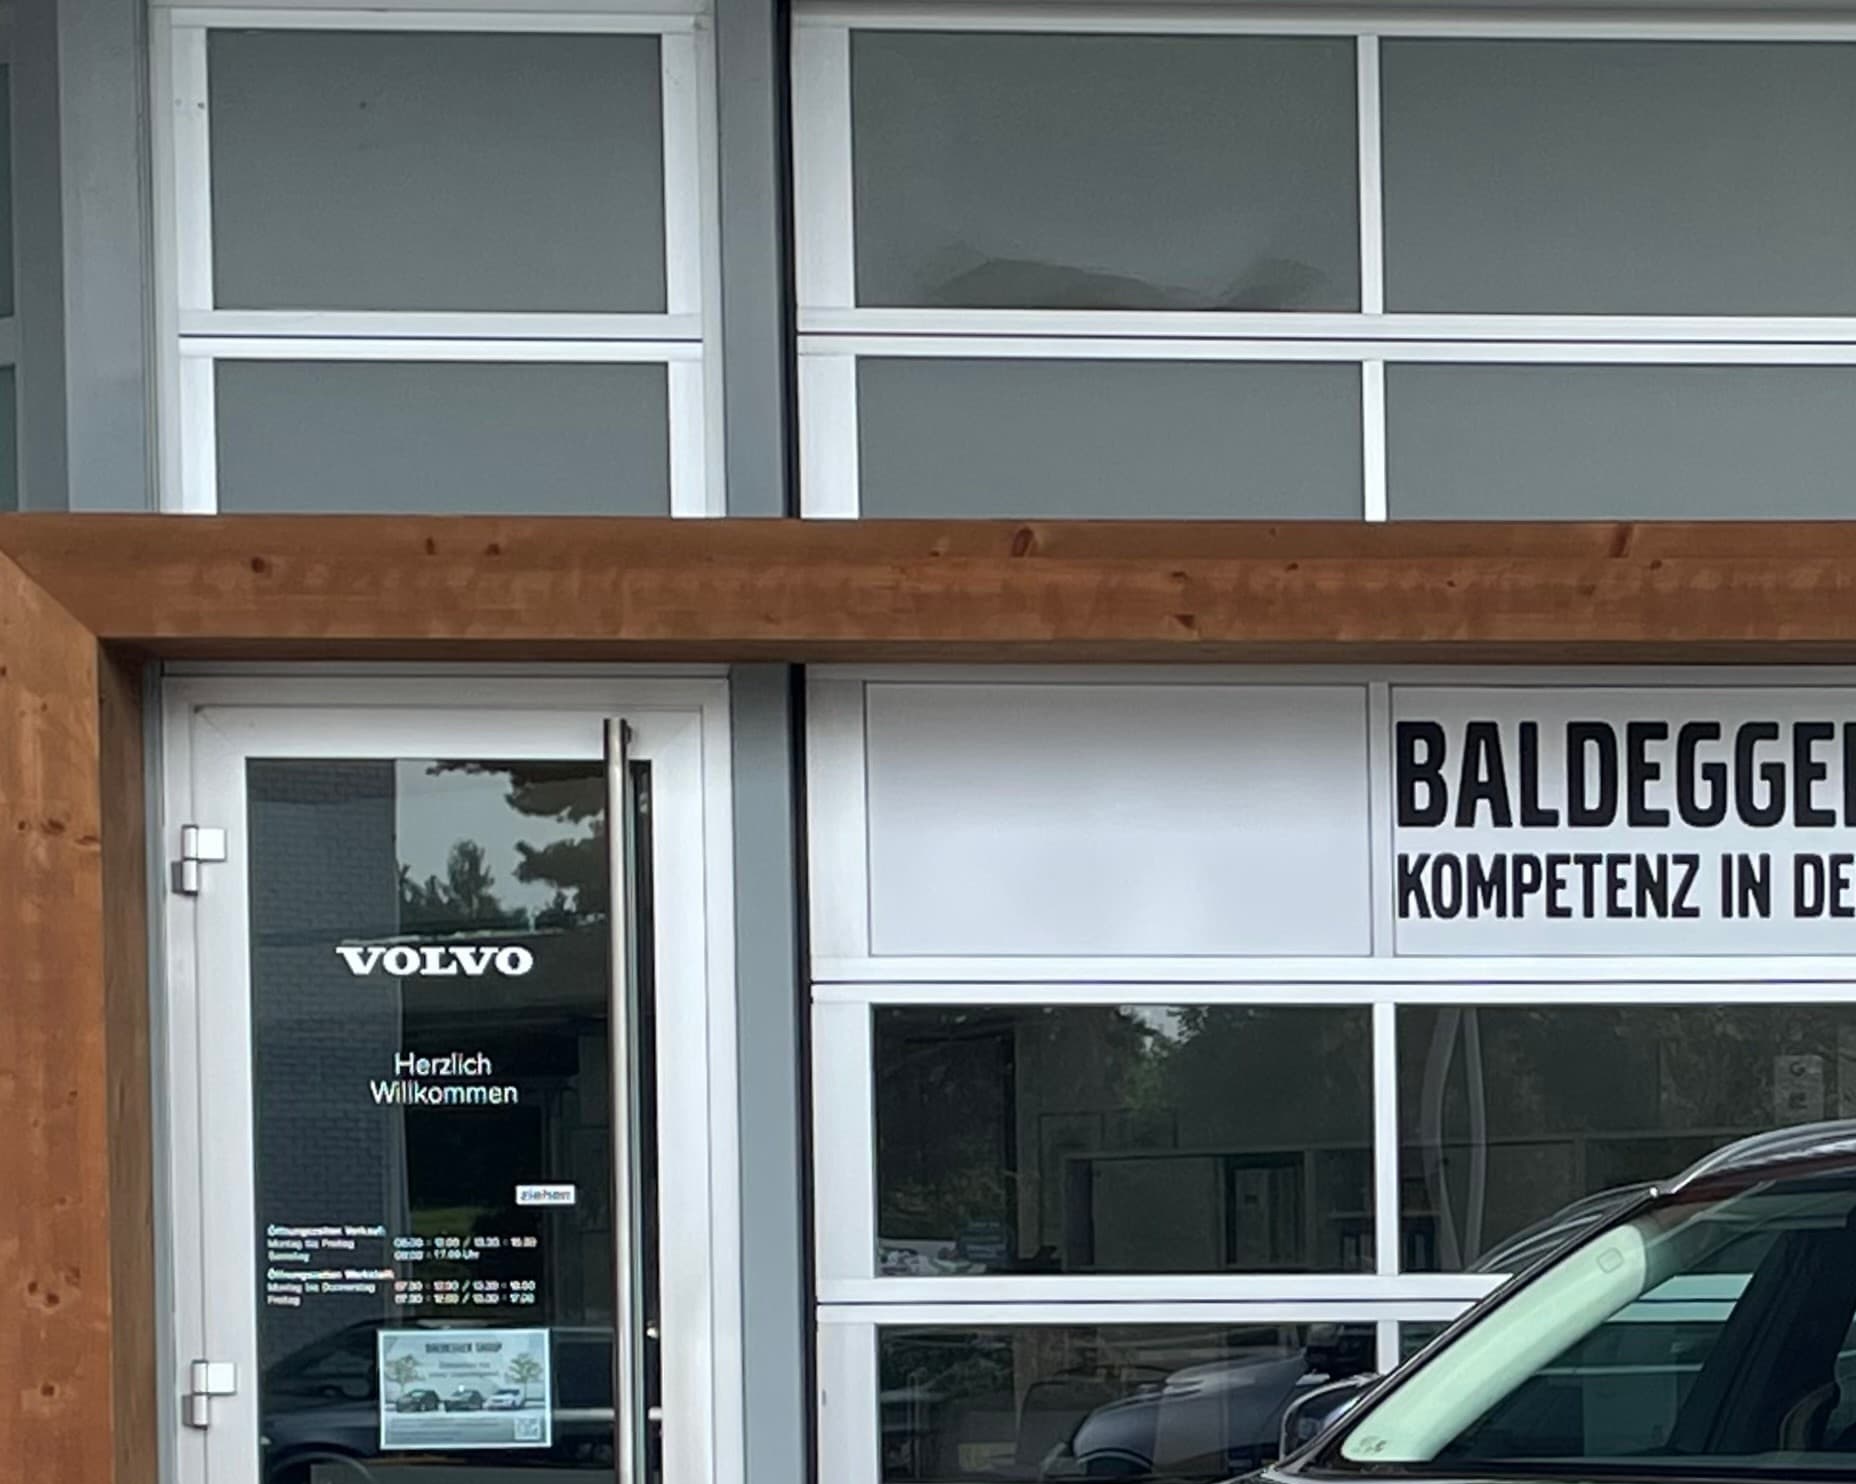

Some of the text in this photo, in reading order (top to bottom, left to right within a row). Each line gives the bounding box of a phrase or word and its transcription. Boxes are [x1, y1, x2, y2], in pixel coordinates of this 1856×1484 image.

[1397, 852, 1701, 919] KOMPETENZ
[1721, 853, 1770, 918] IN
[336, 946, 534, 976] VOLVO
[394, 1052, 492, 1077] Herzlich
[370, 1080, 519, 1105] Willkommen
